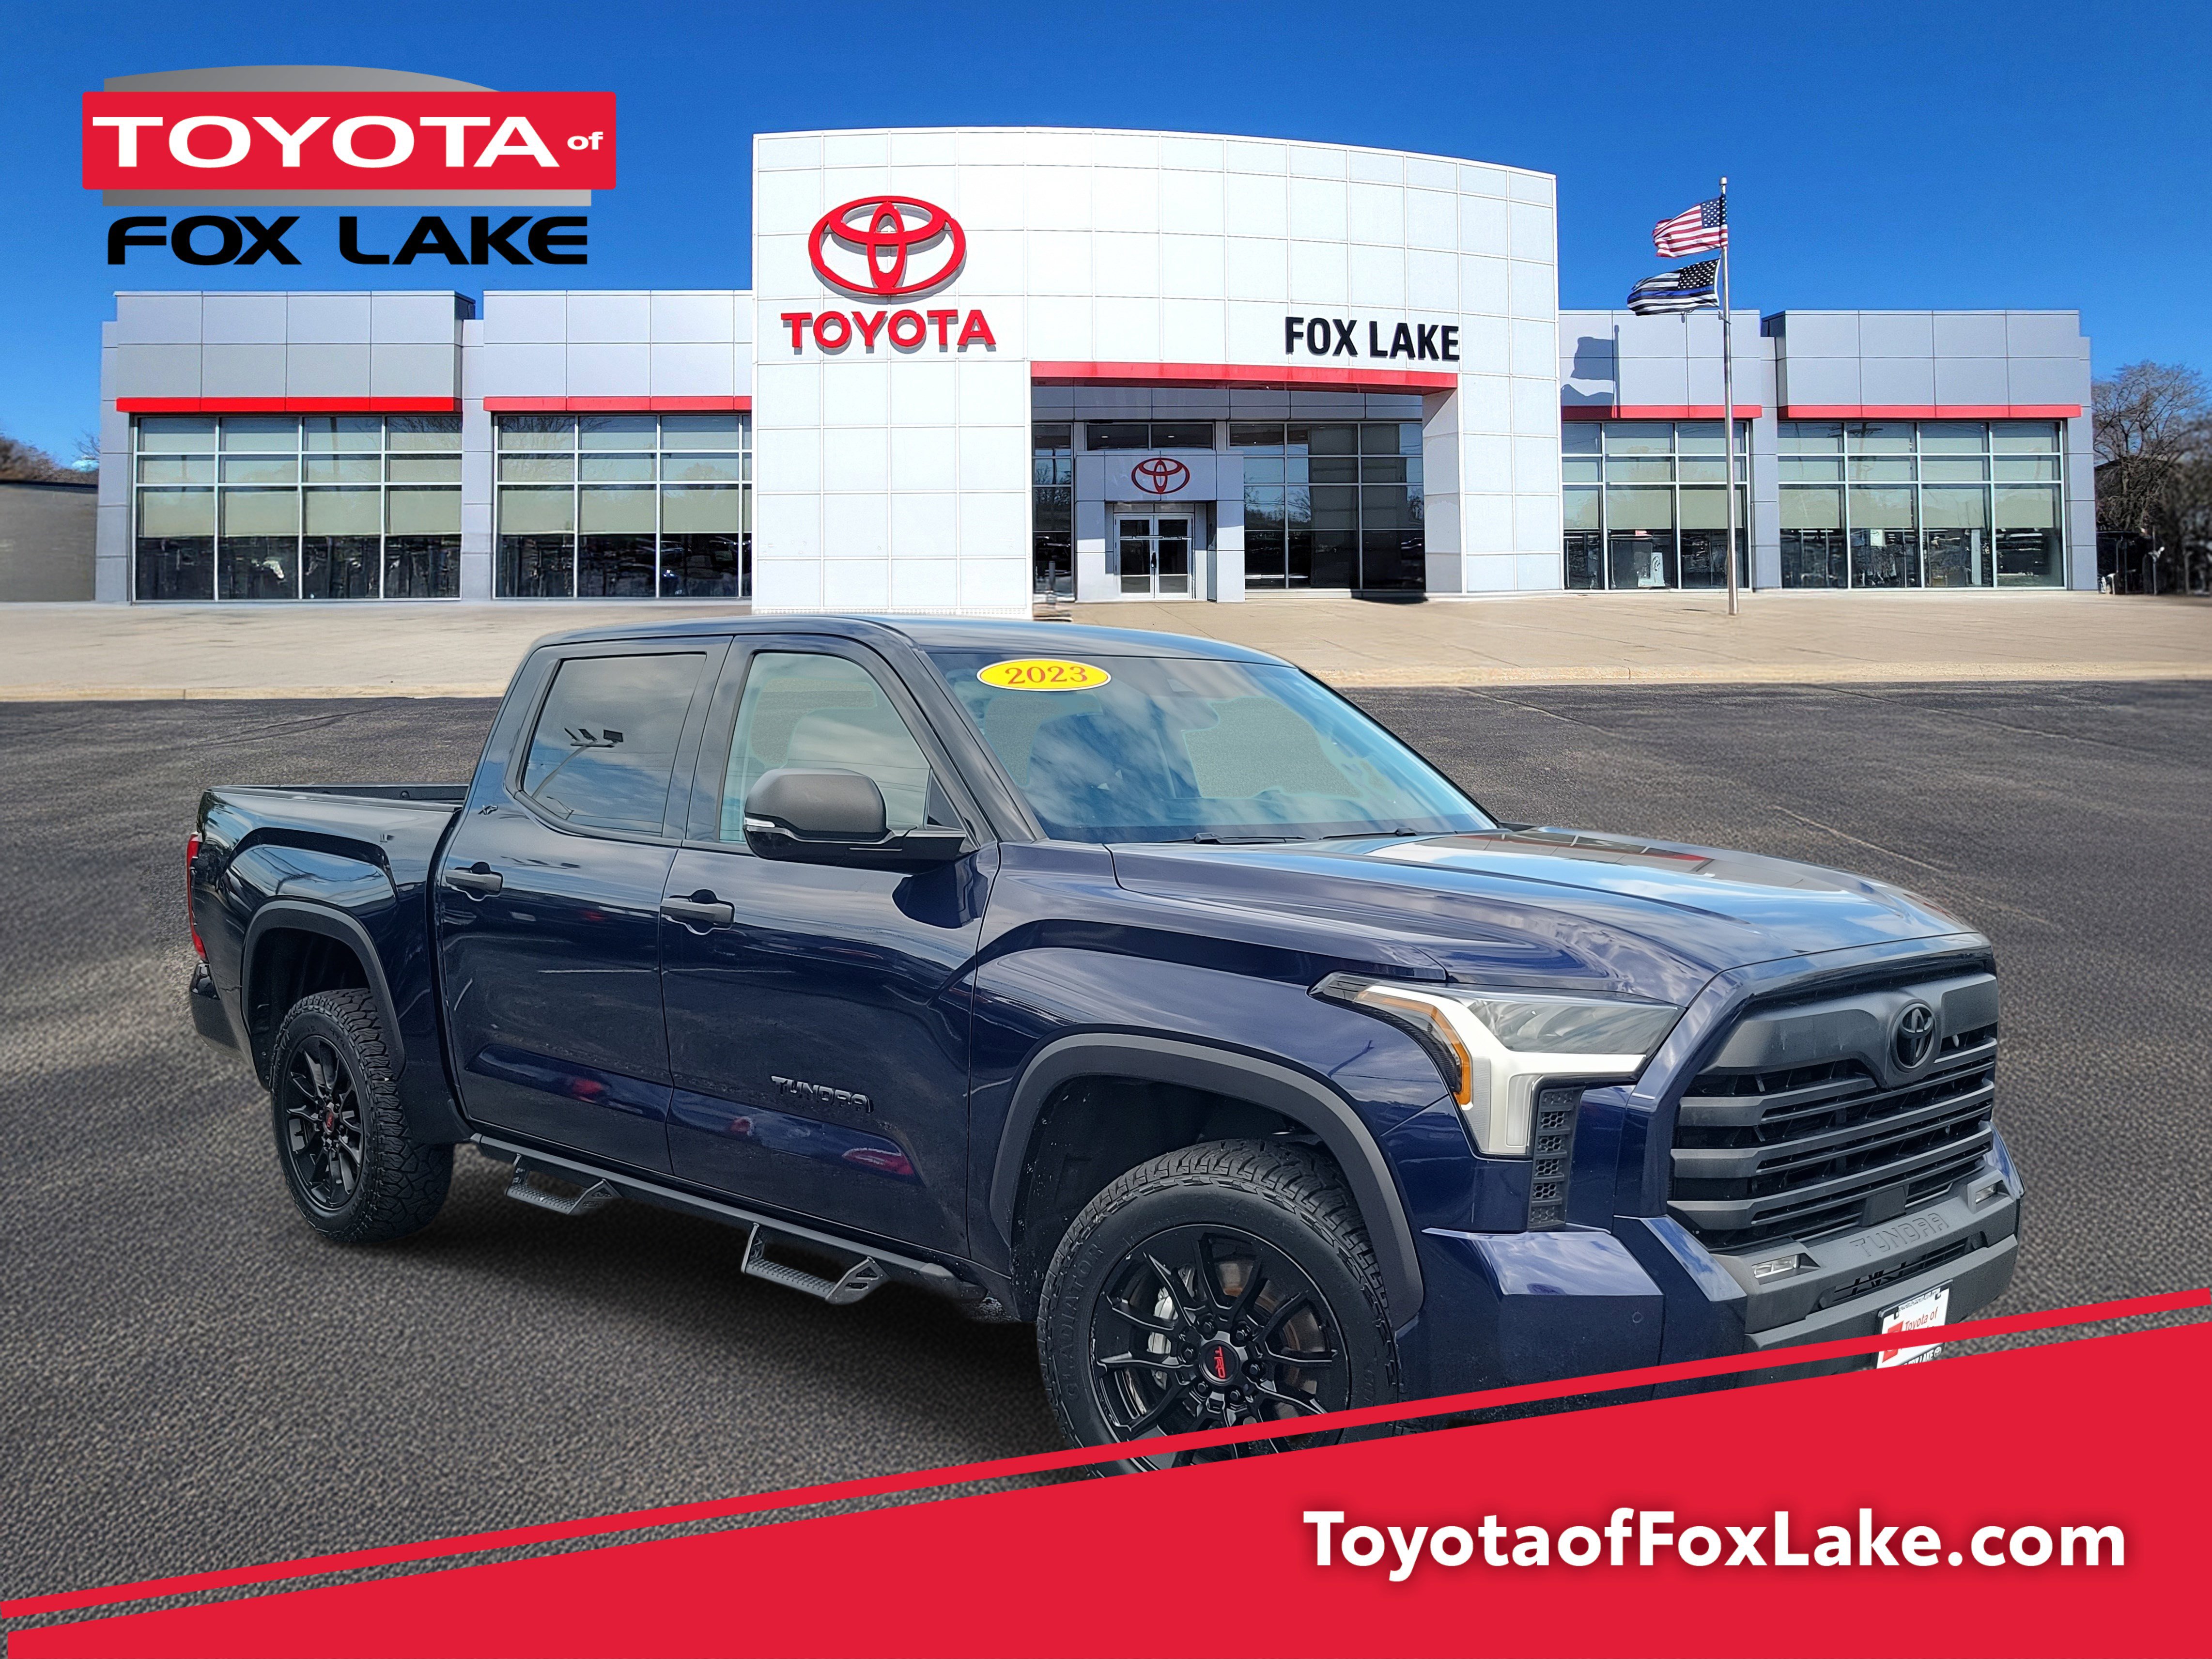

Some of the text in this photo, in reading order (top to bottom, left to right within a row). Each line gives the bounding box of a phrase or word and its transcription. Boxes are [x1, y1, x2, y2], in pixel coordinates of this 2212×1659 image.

[781, 309, 997, 351] TOYOTA
[1285, 316, 1460, 360] FOX LAKE
[1005, 666, 1088, 684] 2023
[771, 1075, 873, 1113] TUNDRA
[1849, 1212, 1950, 1257] TUNDRA
[1905, 1313, 1928, 1331] Toyota
[1930, 1306, 1938, 1320] of
[1214, 1346, 1226, 1380] TRD
